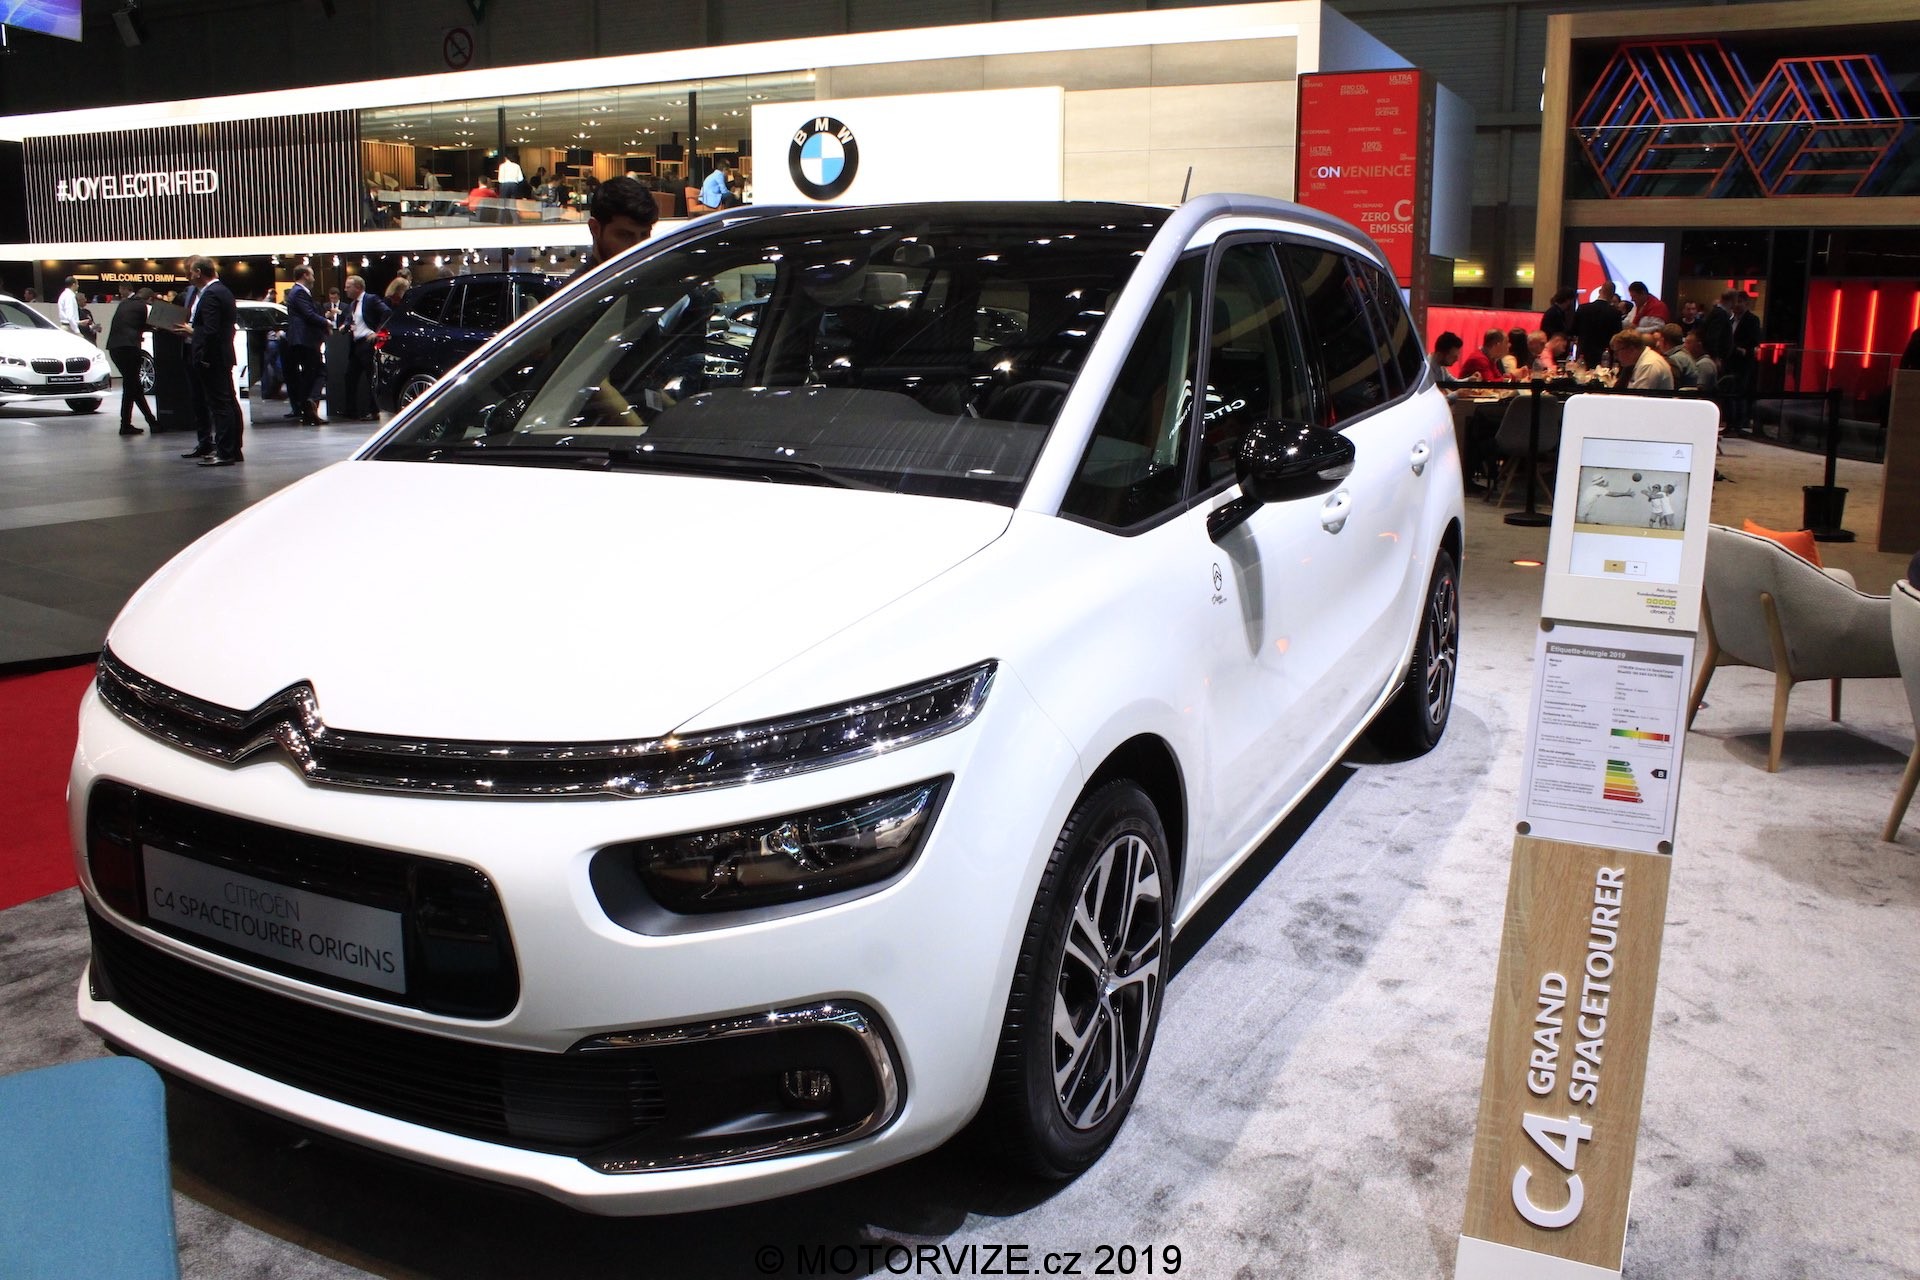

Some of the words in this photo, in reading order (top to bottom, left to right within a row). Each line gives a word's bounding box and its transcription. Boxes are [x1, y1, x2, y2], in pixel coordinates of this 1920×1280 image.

[793, 117, 853, 146] BMW
[1309, 165, 1412, 178] CONVENIENCE
[1360, 212, 1390, 222] ZERO
[101, 273, 142, 282] WELCOME
[142, 274, 154, 282] TO
[155, 274, 174, 282] BMW
[1609, 651, 1626, 659] 2019
[153, 887, 175, 911] C4
[179, 895, 304, 951] SPACETOURER
[309, 933, 396, 974] ORIGINS
[1569, 866, 1626, 1106] SPACETOURER
[1527, 972, 1568, 1095] GRAND
[1512, 1112, 1593, 1228] C4
